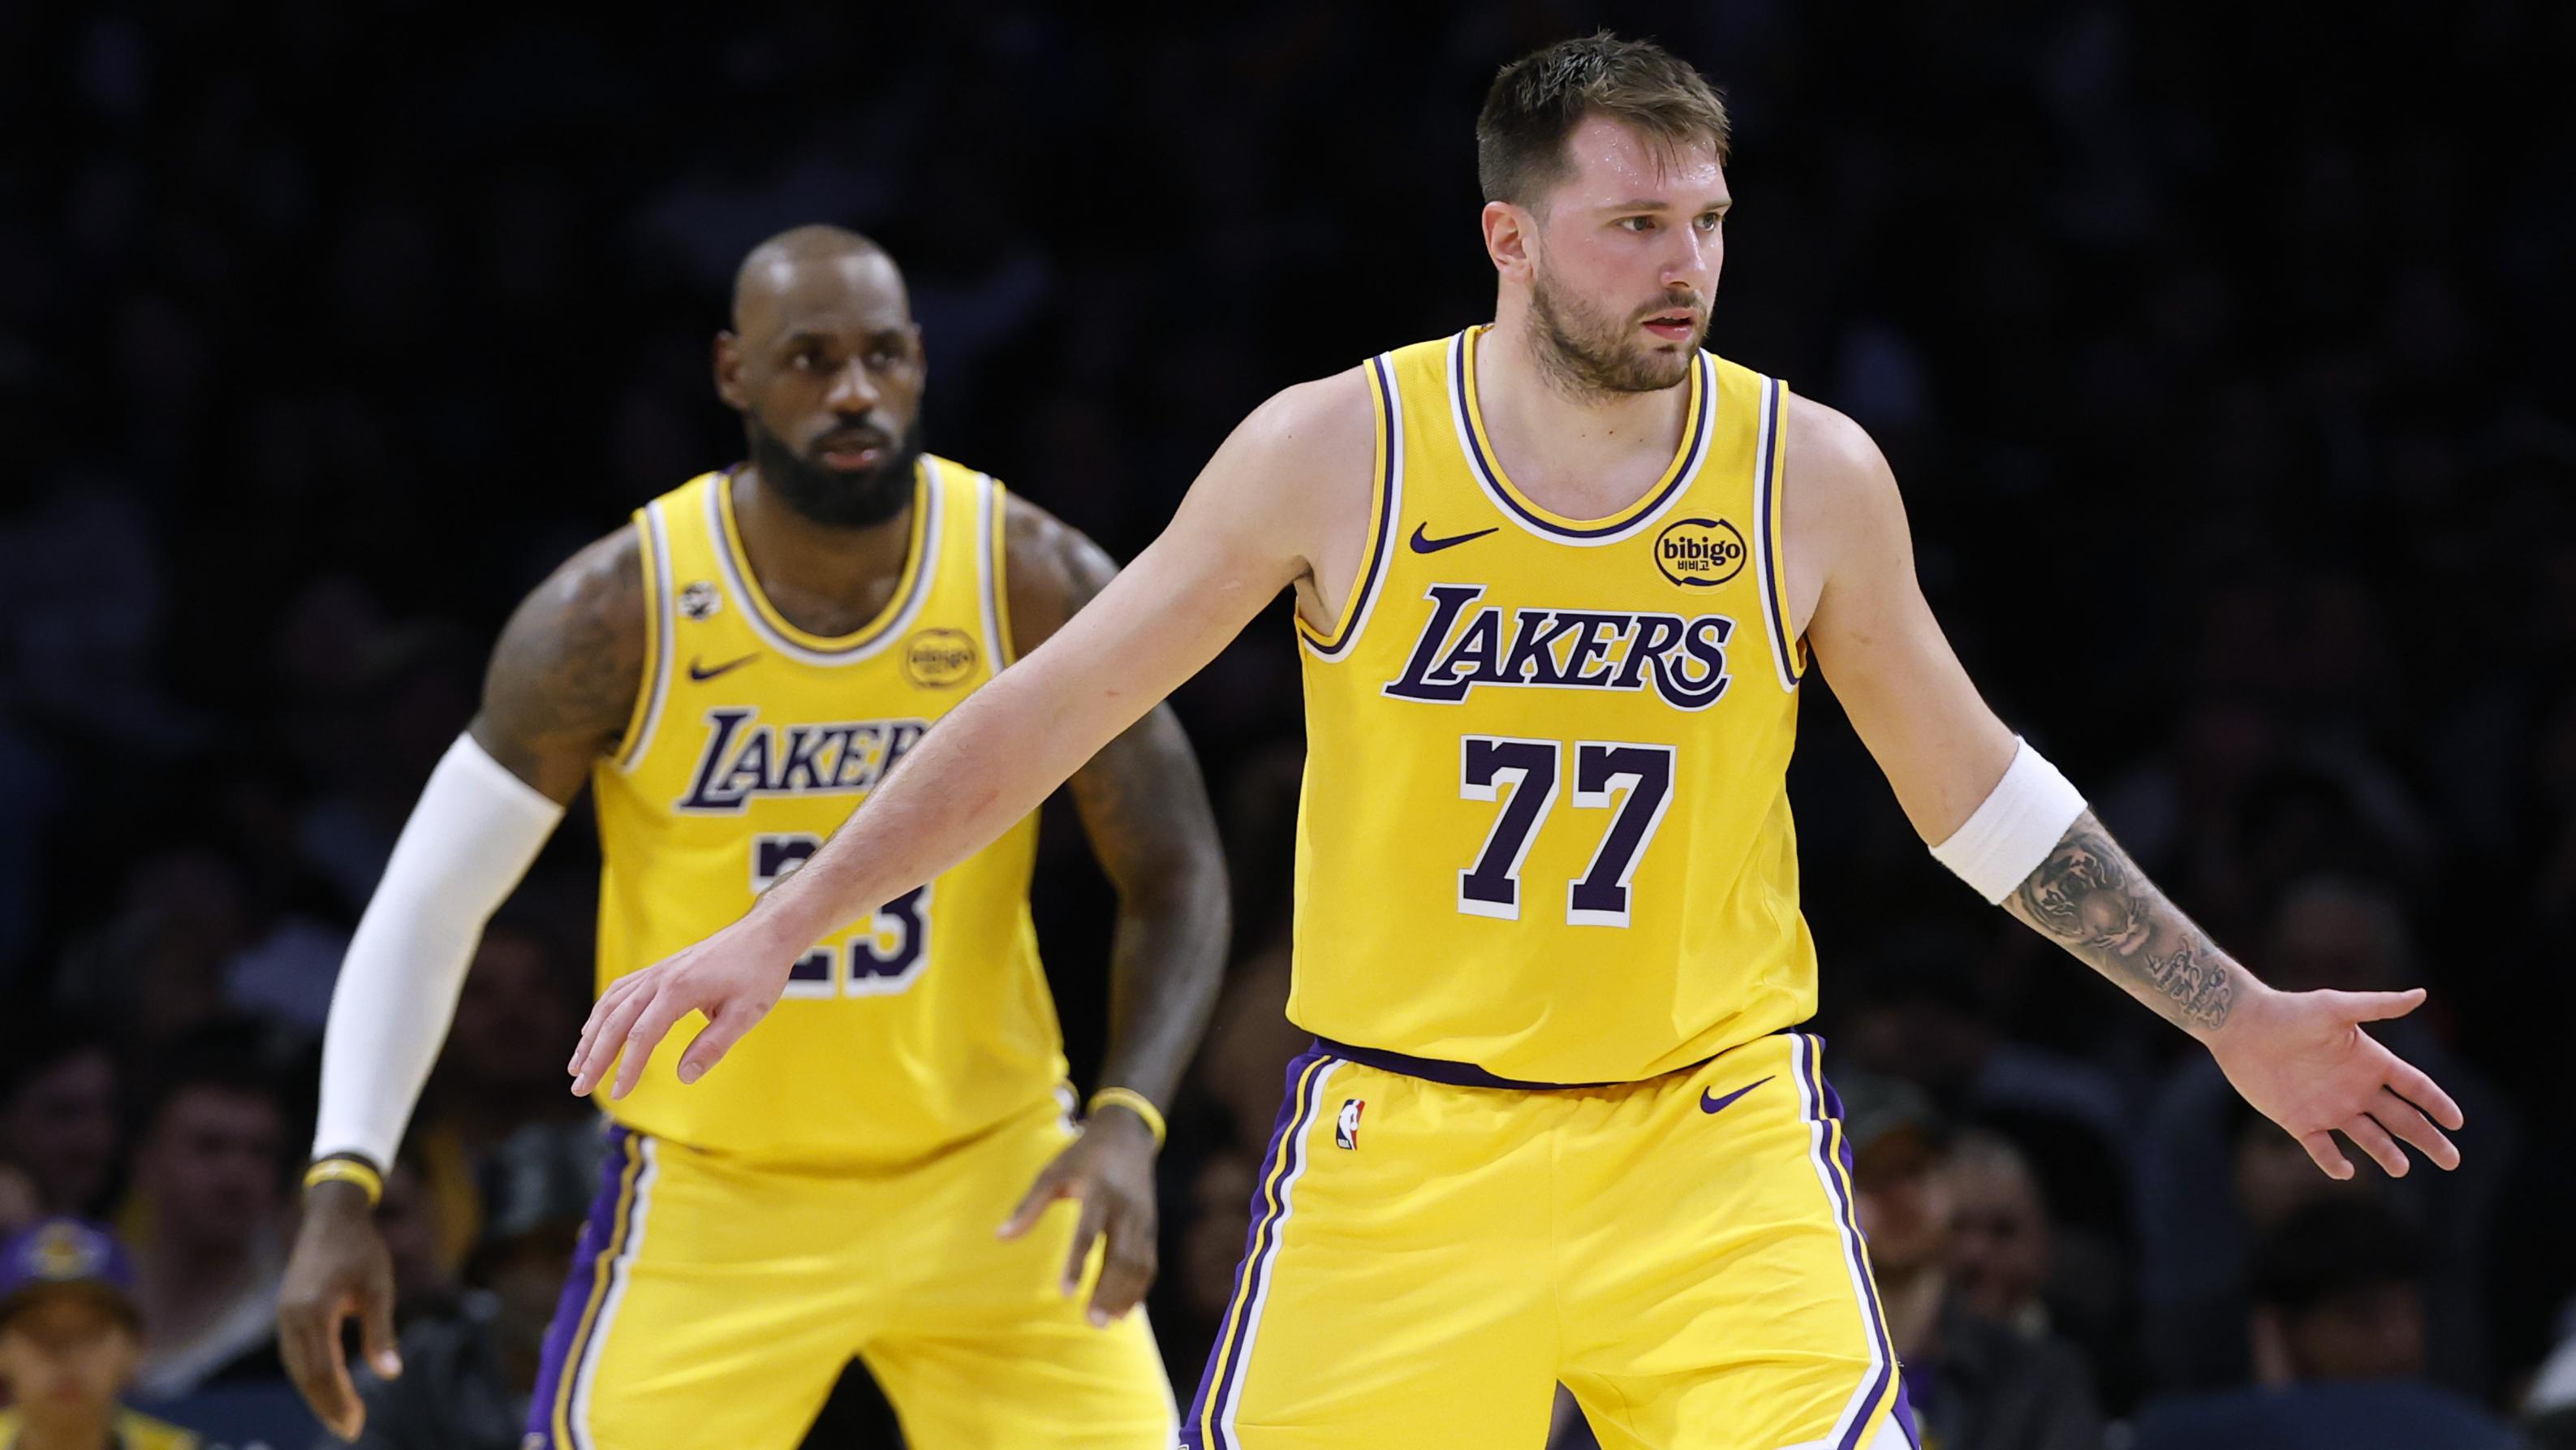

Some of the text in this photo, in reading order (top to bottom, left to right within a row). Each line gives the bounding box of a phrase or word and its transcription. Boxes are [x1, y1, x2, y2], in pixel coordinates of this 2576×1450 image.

[1664, 536, 1741, 567] bibigo
[1677, 560, 1710, 572] 비비고
[1381, 583, 1736, 711] LAKERS
[675, 706, 929, 813] LAKE
[1458, 734, 1677, 928] 77
